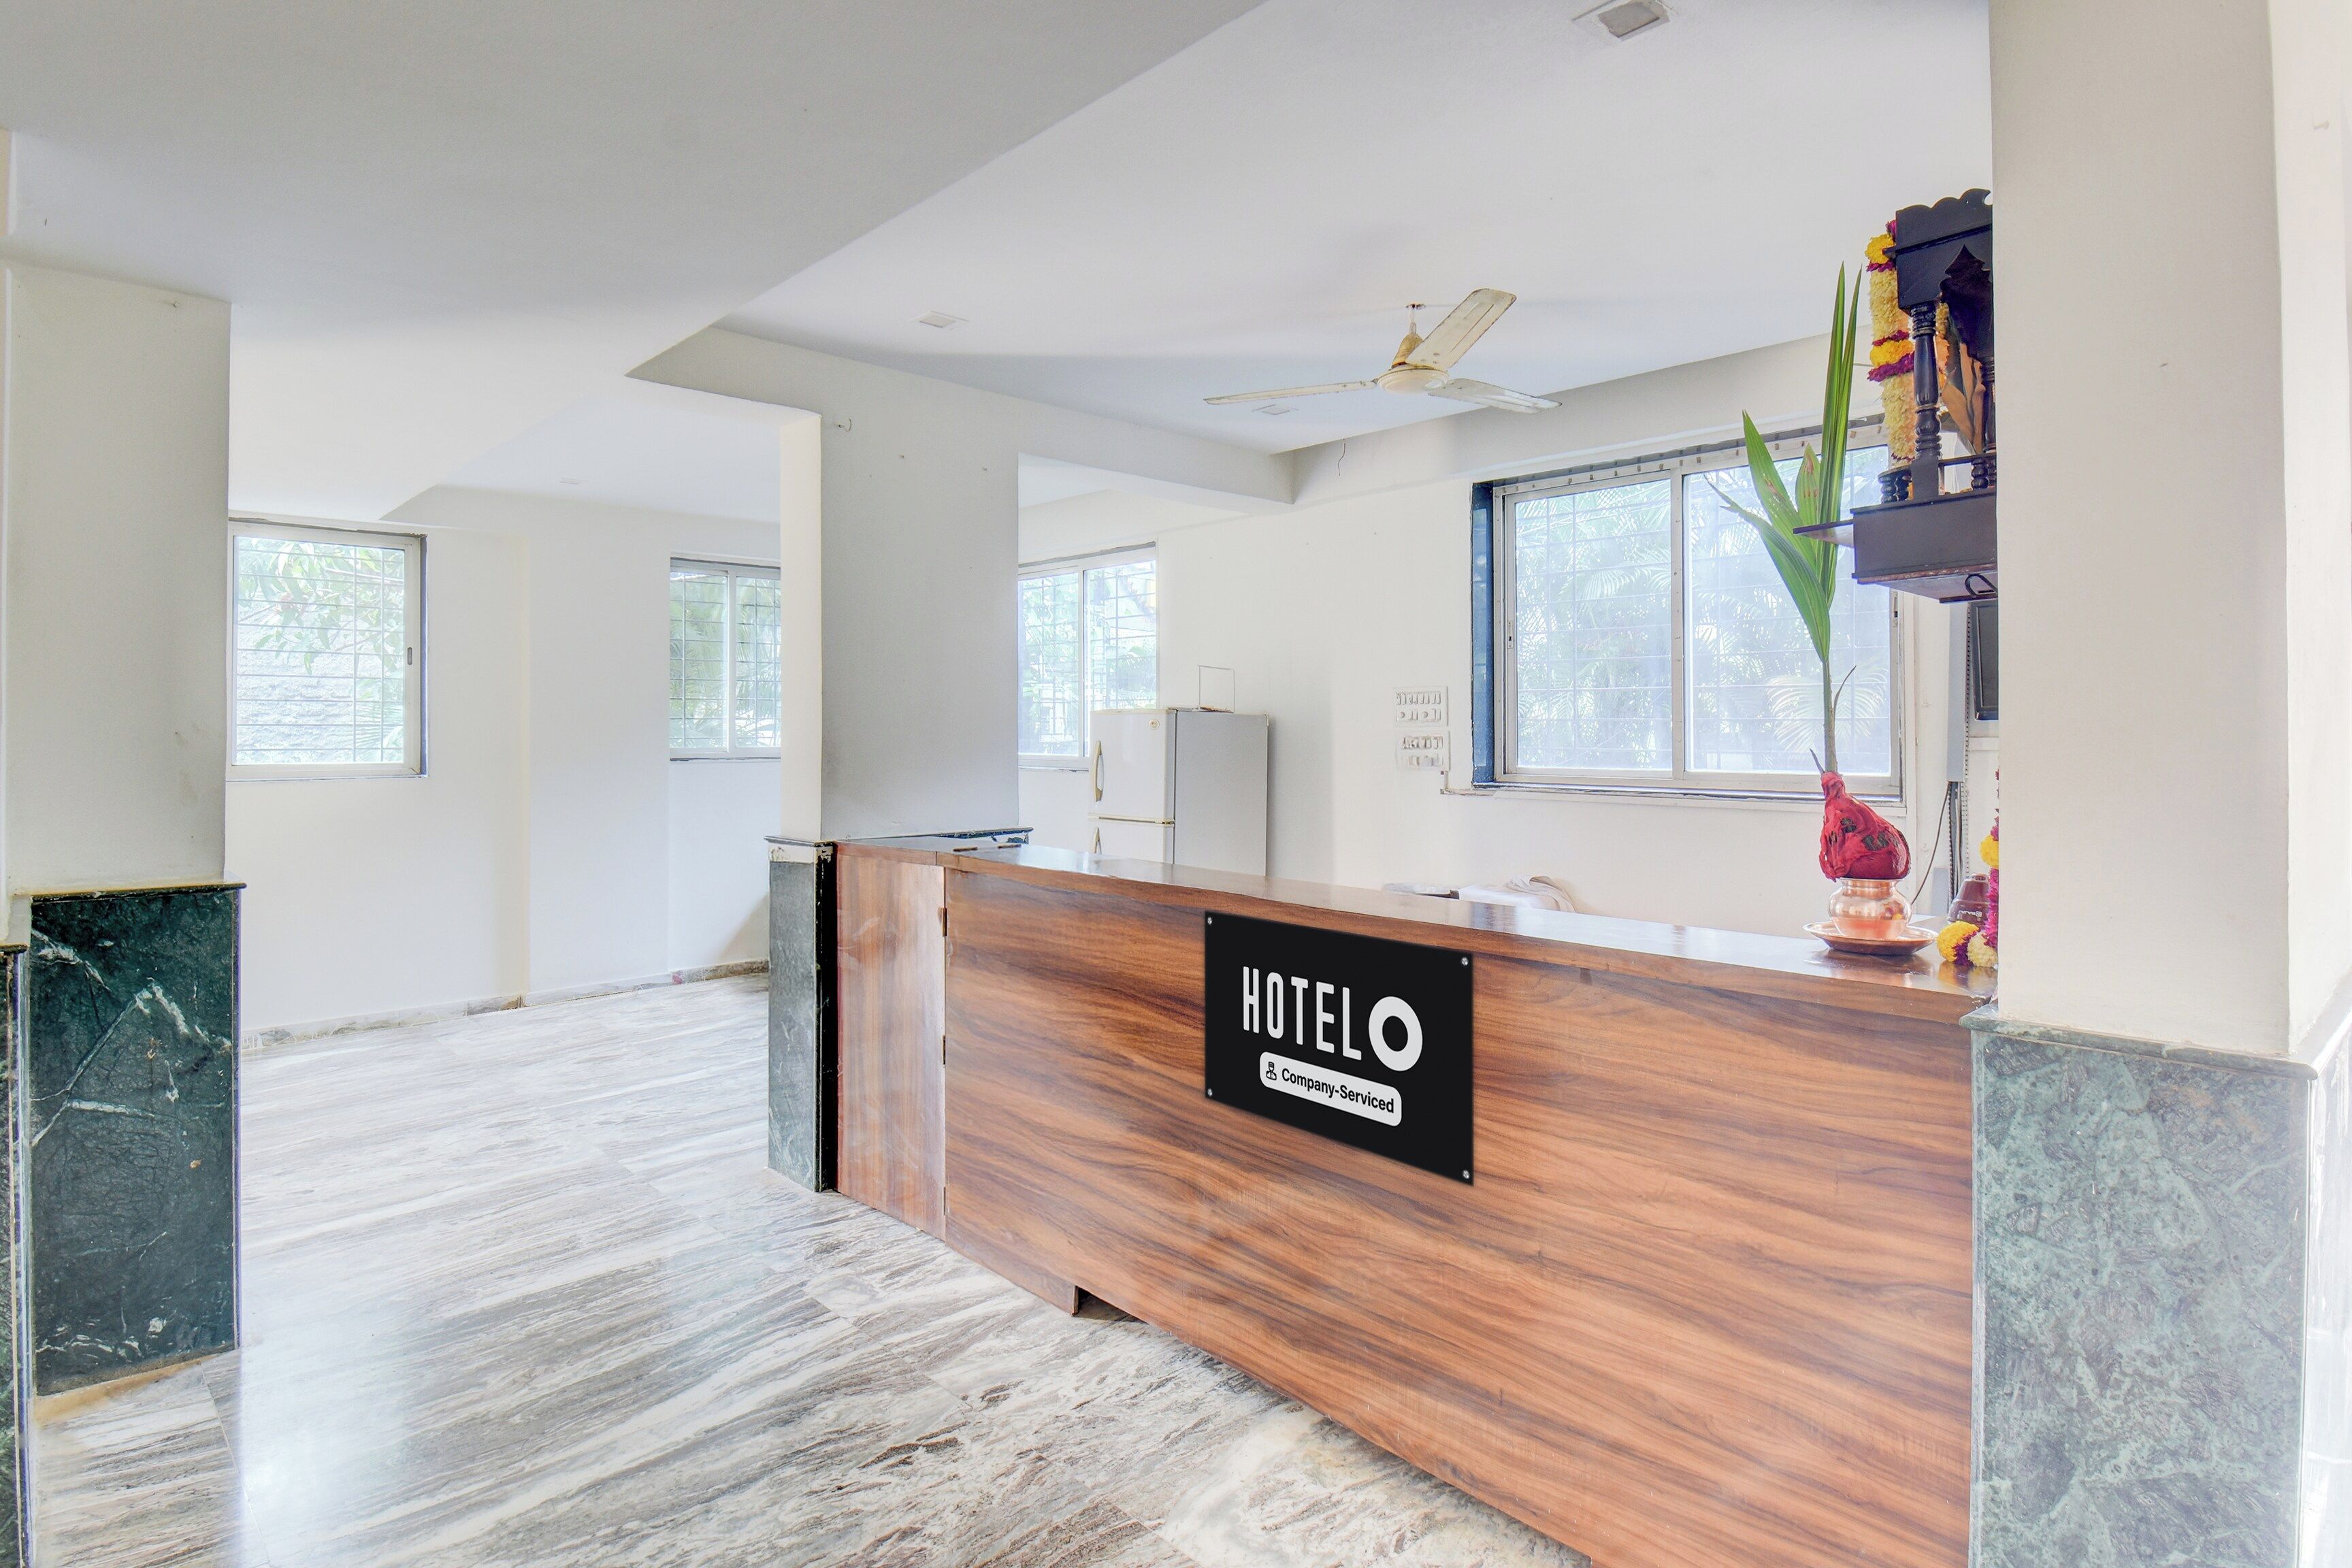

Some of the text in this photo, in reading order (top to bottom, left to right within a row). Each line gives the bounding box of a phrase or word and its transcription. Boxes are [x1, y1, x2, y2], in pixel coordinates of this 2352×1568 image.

[1243, 966, 1423, 1072] HOTEL O
[1281, 1068, 1394, 1113] Company-Serviced
